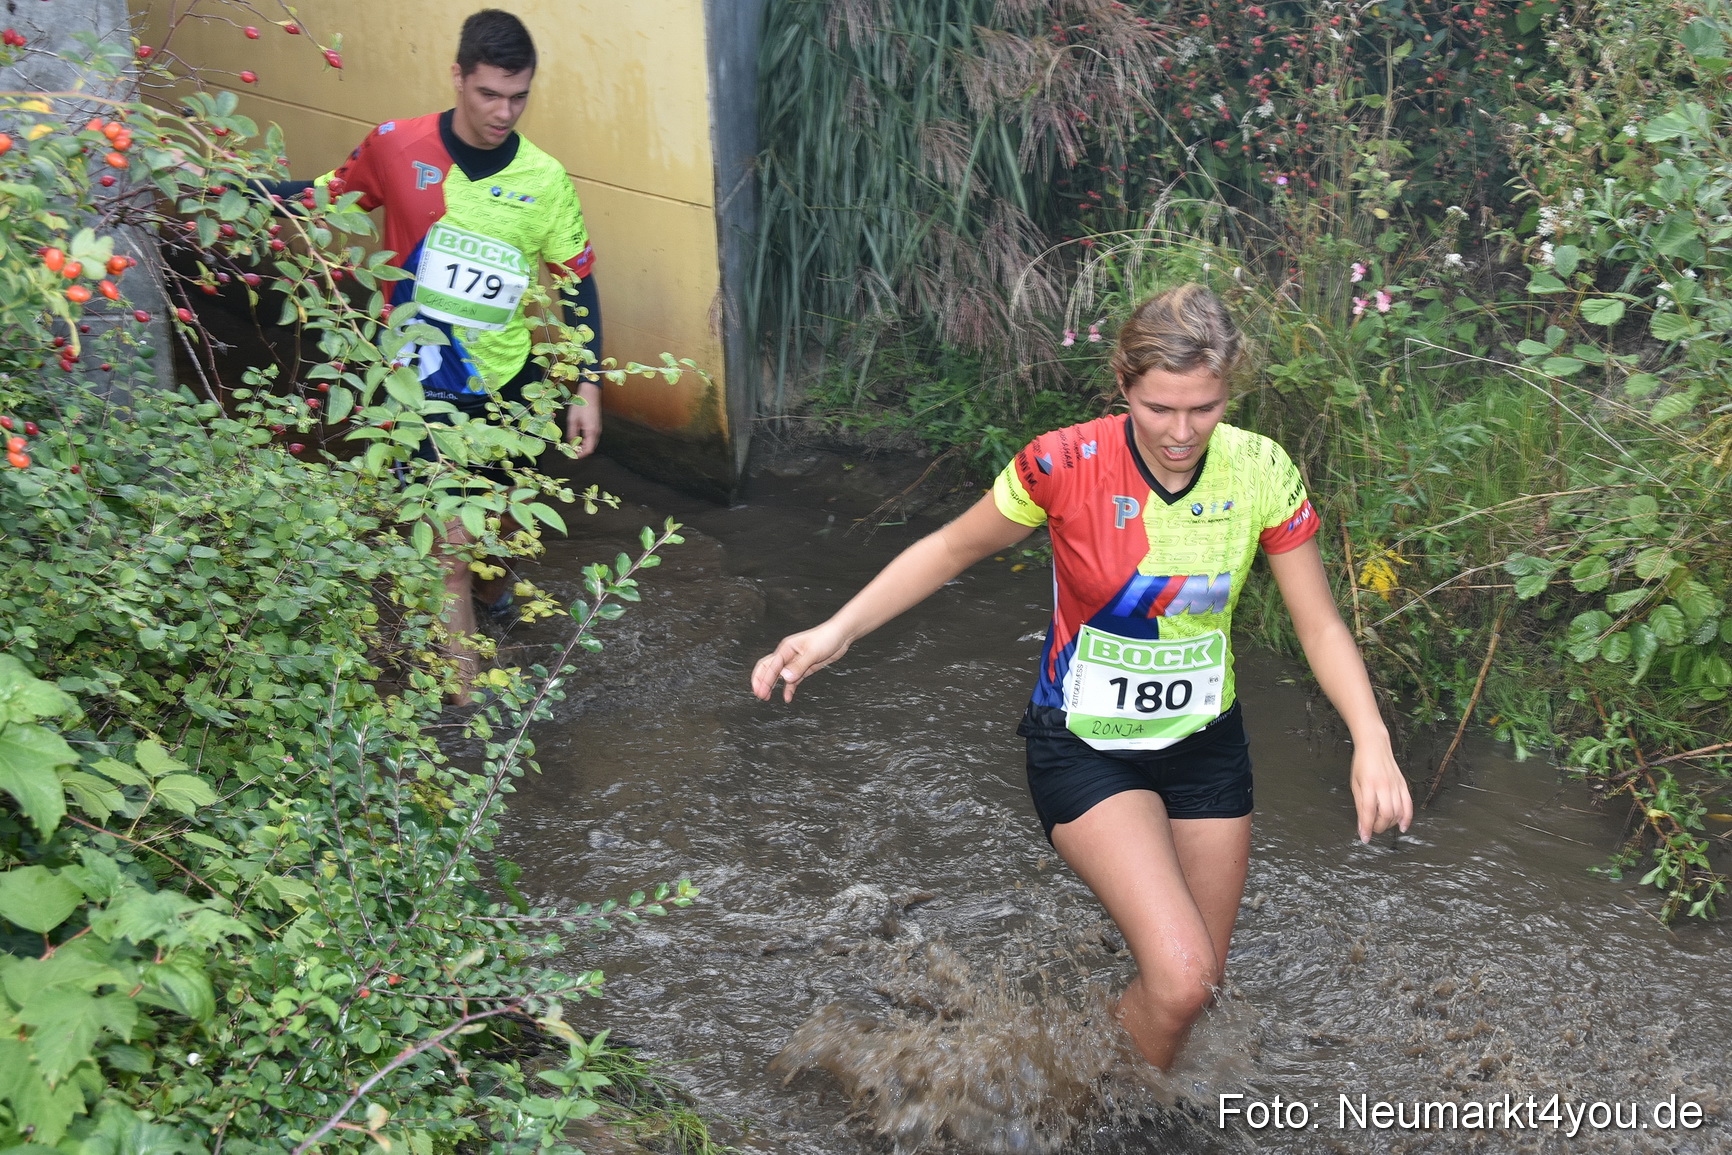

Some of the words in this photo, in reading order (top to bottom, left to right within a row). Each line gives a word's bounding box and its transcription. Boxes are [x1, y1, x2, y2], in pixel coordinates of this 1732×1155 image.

[435, 228, 521, 270] BOCK
[446, 262, 504, 300] 179
[1090, 637, 1213, 669] BOCK
[1109, 676, 1193, 714] 180
[1092, 720, 1145, 736] RONJA
